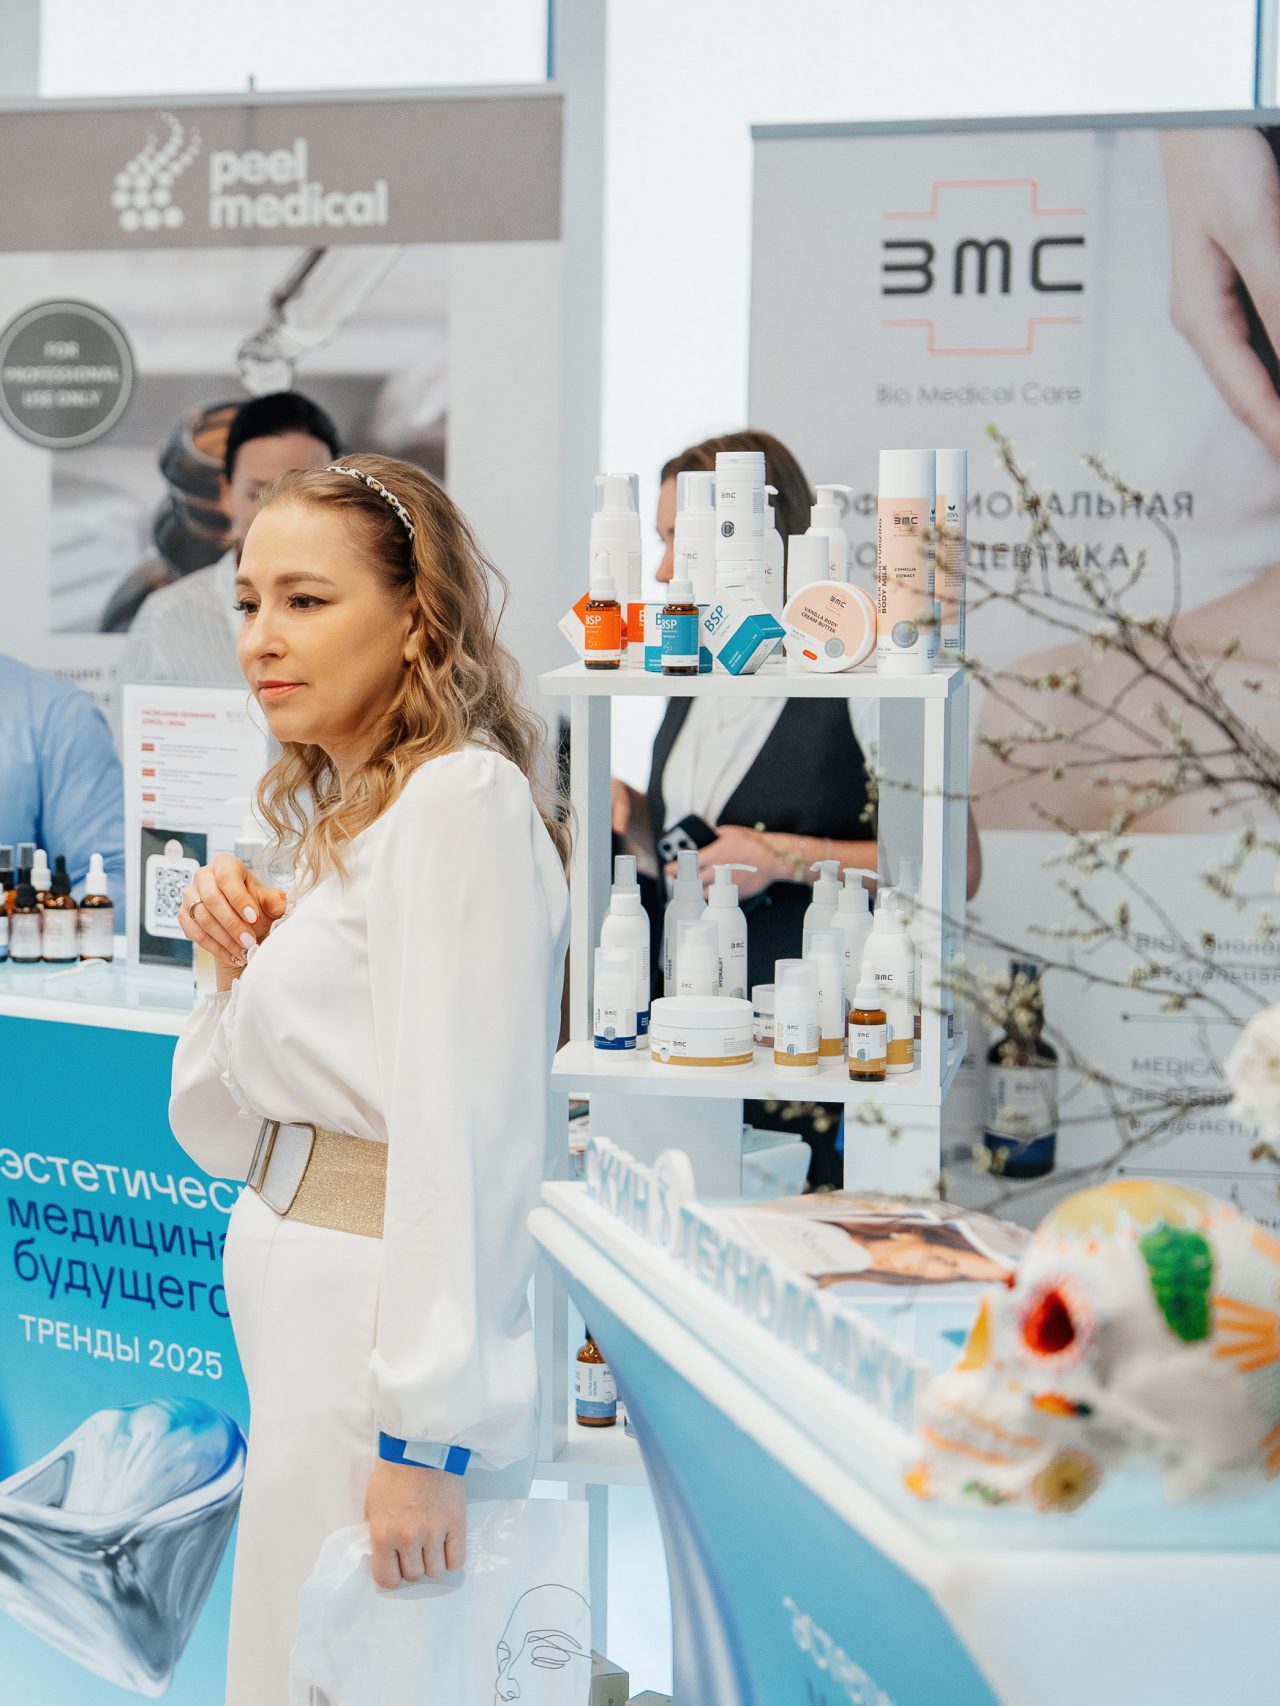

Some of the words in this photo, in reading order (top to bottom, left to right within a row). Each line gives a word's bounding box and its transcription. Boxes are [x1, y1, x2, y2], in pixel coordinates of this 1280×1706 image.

[208, 137, 308, 189] peel
[208, 180, 389, 229] medical
[881, 235, 1086, 296] BMC
[43, 340, 80, 361] FOR
[3, 365, 120, 385] PROFESSIONAL
[21, 389, 53, 409] USE
[54, 389, 103, 408] ONLY
[875, 383, 910, 404] Bio
[919, 382, 1015, 404] Medical
[1022, 380, 1082, 402] Care
[585, 614, 602, 625] BSP
[661, 619, 678, 630] BSP
[703, 604, 724, 633] BSP
[800, 611, 837, 634] CREAM-BUTTER
[803, 606, 825, 621] VANILLA
[823, 616, 839, 629] BODY
[13, 1236, 231, 1319] будущего
[18, 1313, 140, 1363] ТРЕНДЫ
[148, 1339, 223, 1381] 2025
